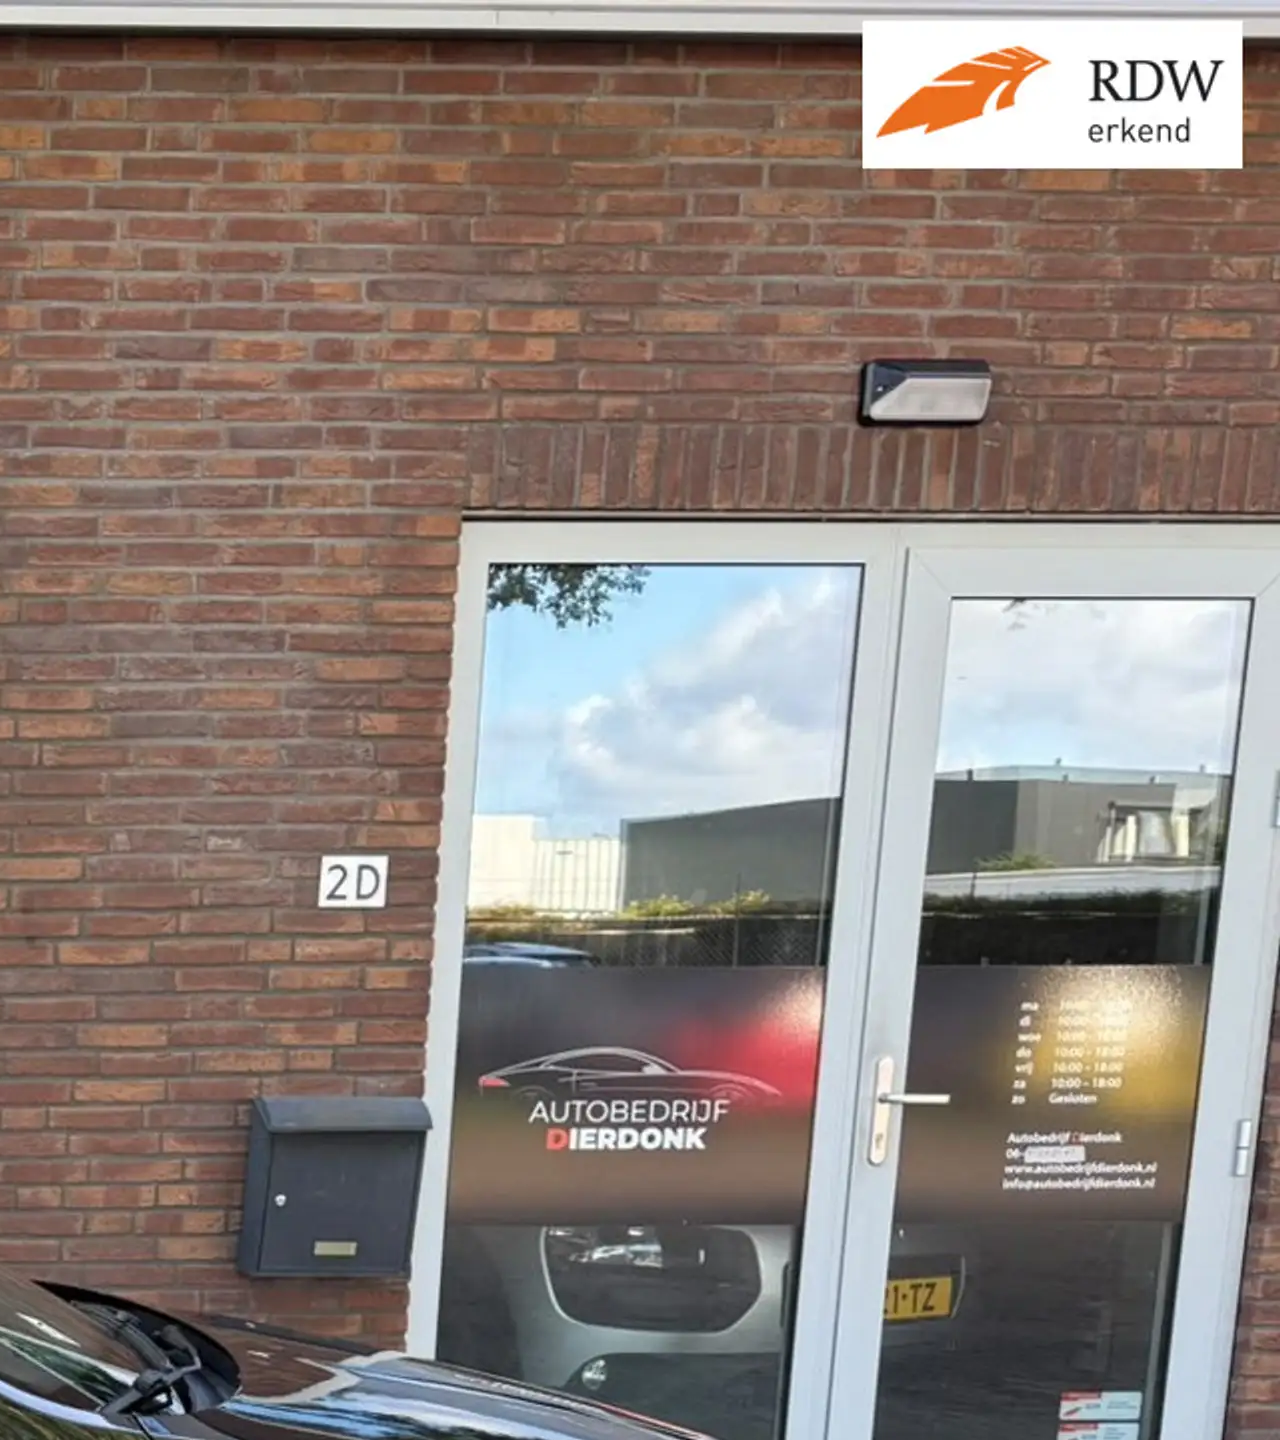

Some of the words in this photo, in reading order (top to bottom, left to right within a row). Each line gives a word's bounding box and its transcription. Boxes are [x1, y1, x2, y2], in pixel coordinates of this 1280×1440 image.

[326, 864, 380, 900] 2D
[1048, 1092, 1098, 1104] Gesloten
[528, 1099, 731, 1124] AUTOBEDRIJF
[546, 1127, 706, 1151] DIERDONK
